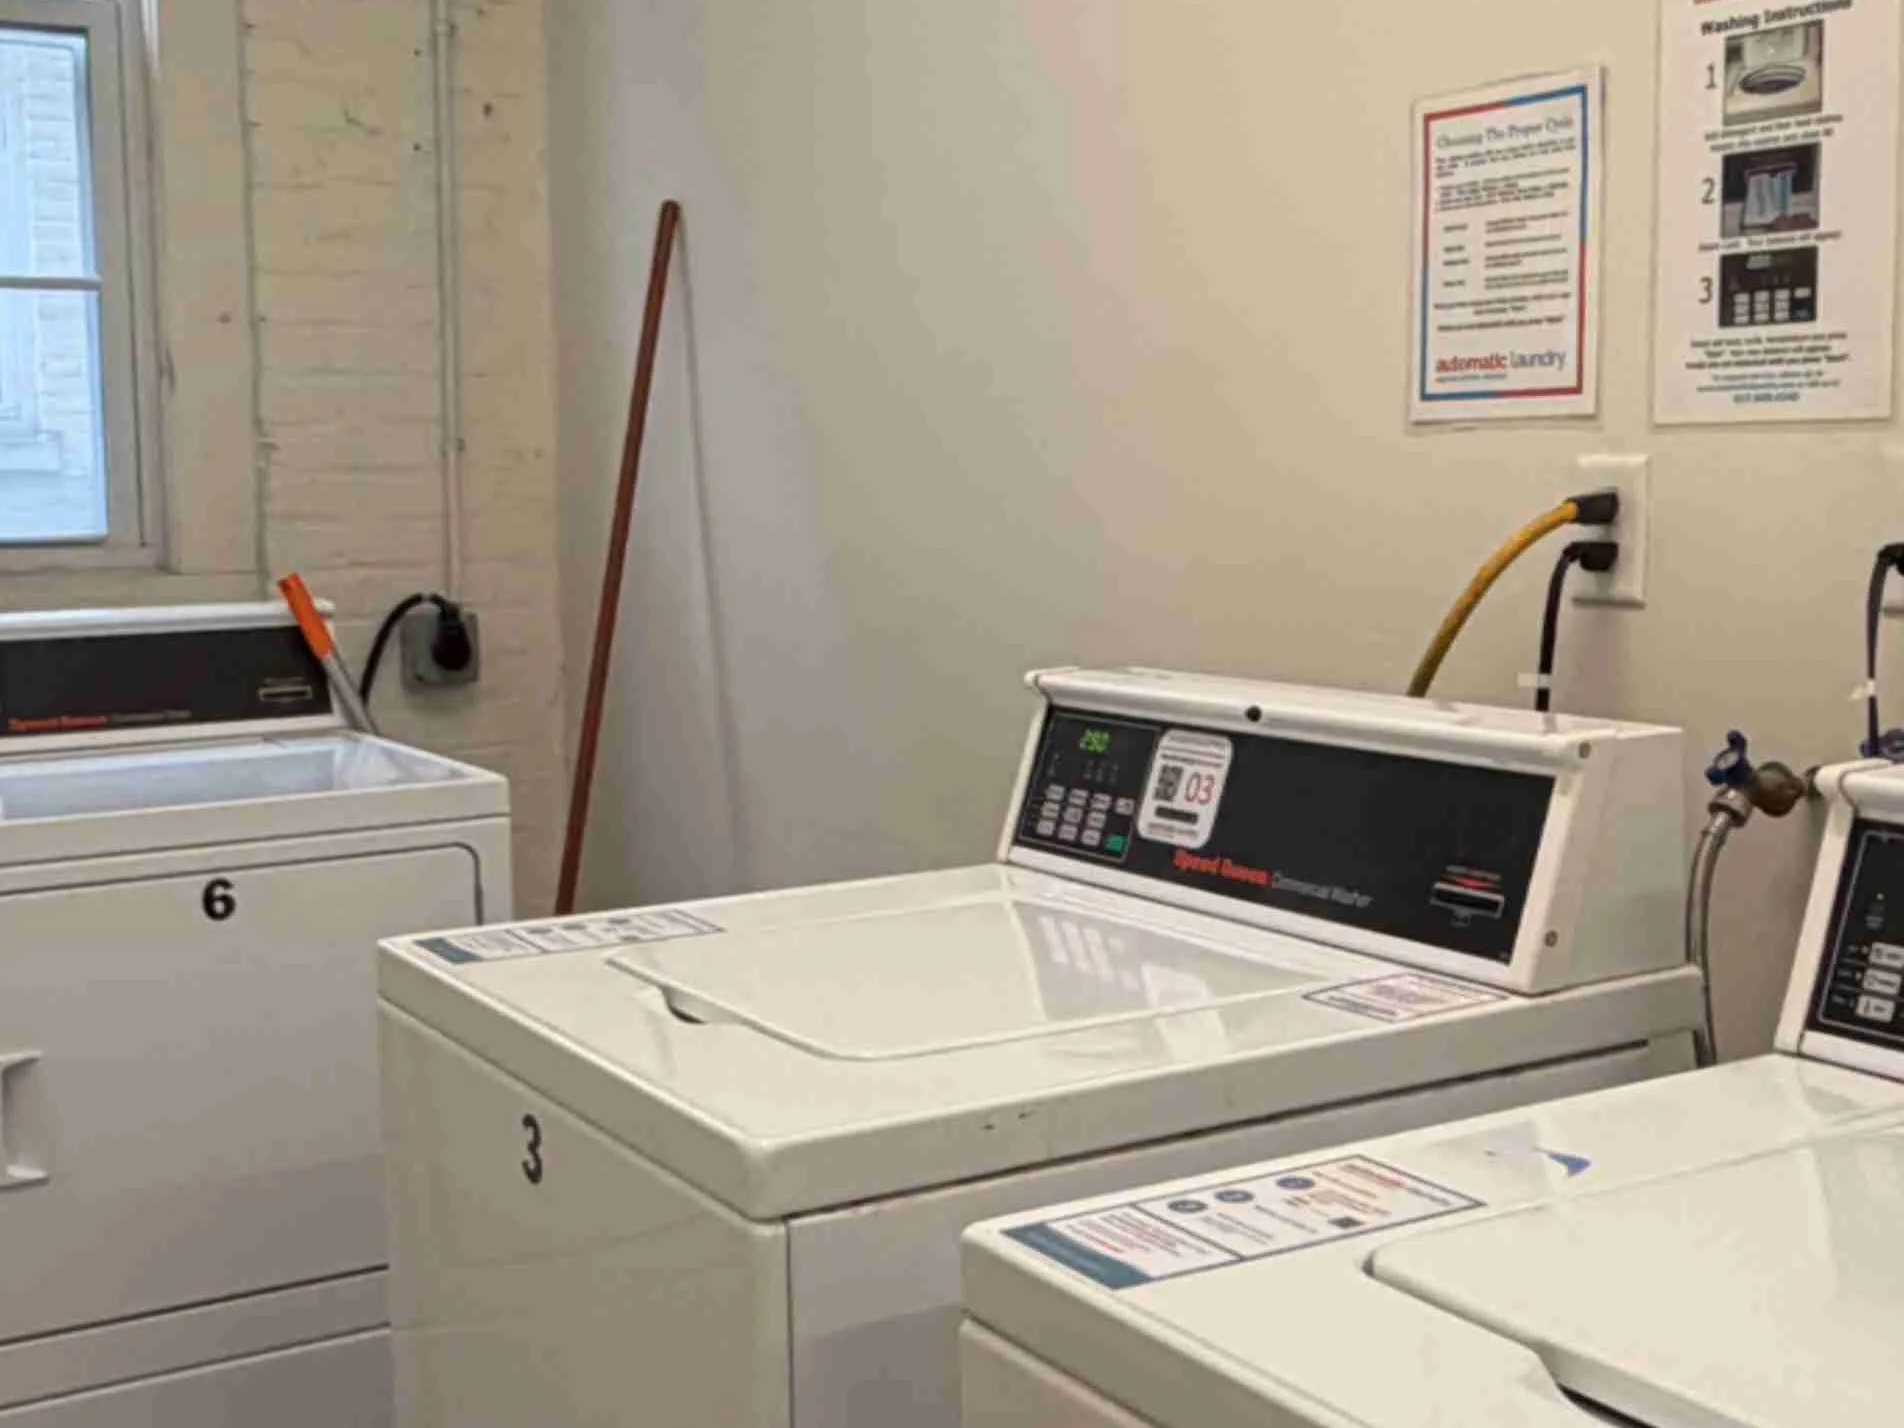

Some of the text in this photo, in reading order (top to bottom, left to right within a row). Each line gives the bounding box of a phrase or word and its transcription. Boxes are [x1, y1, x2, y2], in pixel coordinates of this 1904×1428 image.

[1701, 12, 1760, 36] Washing
[1705, 63, 1717, 90] 1
[1701, 177, 1715, 205] 2
[1698, 276, 1714, 304] 3
[1435, 349, 1567, 373] automatic laundry
[1184, 771, 1216, 805] 03
[201, 877, 237, 922] 6
[521, 1113, 543, 1185] 3
